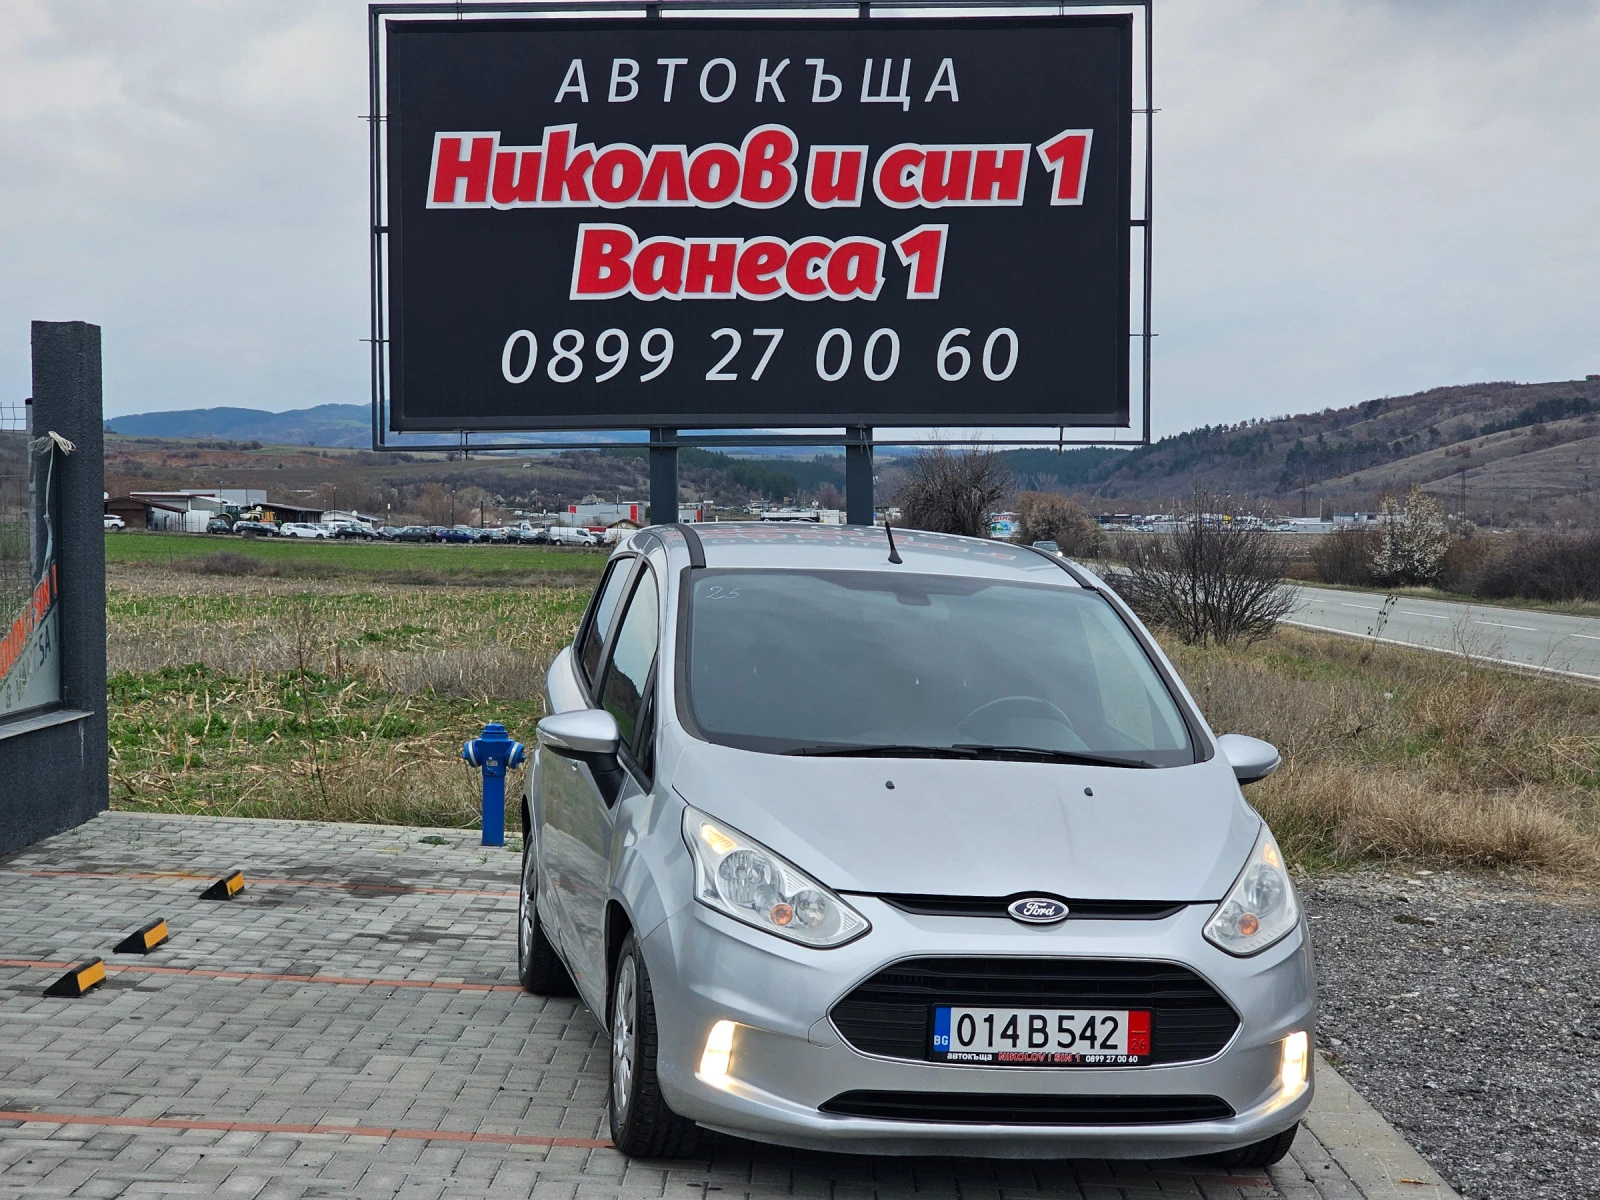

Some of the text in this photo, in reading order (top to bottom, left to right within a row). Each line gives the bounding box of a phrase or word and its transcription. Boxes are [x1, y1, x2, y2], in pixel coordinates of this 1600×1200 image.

[554, 57, 960, 112] АВТОКЪЩА
[426, 123, 1094, 209] Николов и син 1
[569, 223, 949, 302] Ванеса 1
[501, 327, 1019, 383] 0899 27 00 60
[1023, 901, 1056, 916] Ford
[933, 1034, 949, 1046] BG
[946, 1052, 993, 1062] автокъща
[998, 1051, 1046, 1062] NIKOLOV
[1054, 1052, 1073, 1063] SIN
[1075, 1053, 1081, 1063] 1
[1085, 1055, 1104, 1063] 0899
[1105, 1055, 1116, 1063] 27
[1117, 1055, 1127, 1063] 00
[1128, 1055, 1139, 1063] 60
